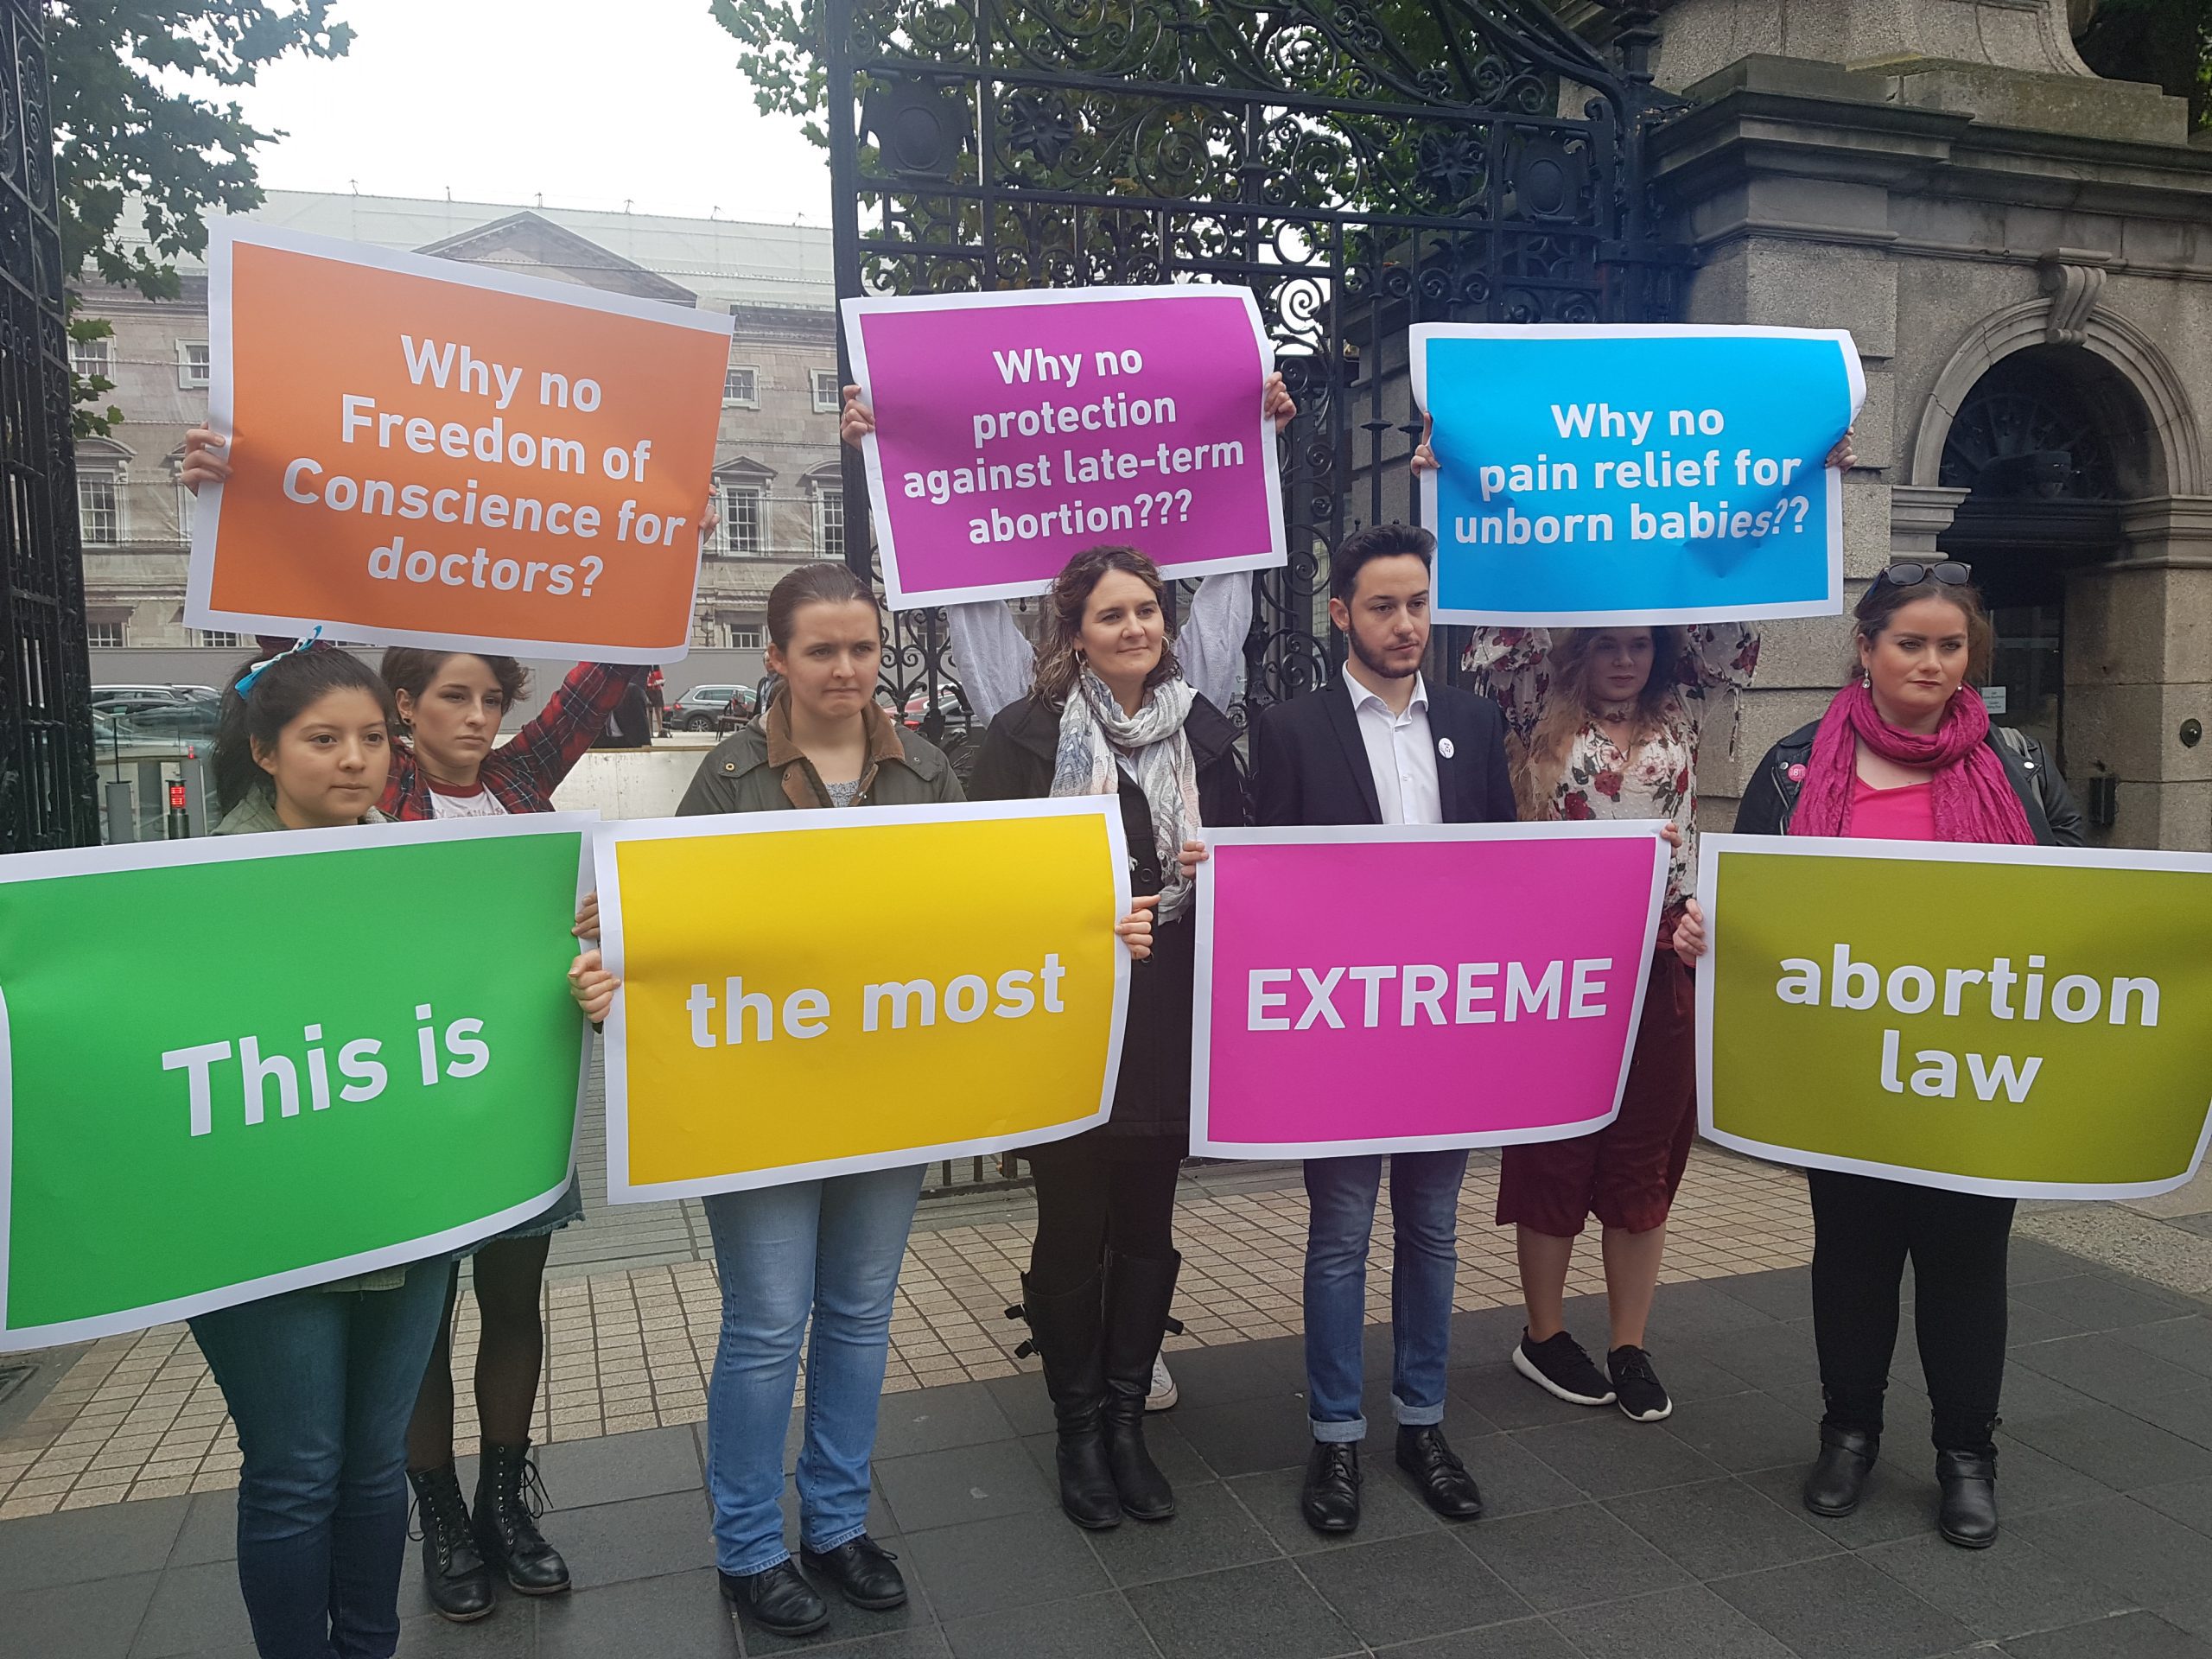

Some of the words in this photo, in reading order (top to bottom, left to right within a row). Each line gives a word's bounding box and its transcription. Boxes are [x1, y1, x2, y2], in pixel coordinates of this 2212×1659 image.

[401, 334, 524, 410] Why
[540, 371, 602, 413] no
[993, 347, 1083, 388] Why
[1095, 349, 1143, 377] no
[341, 394, 586, 475] Freedom
[602, 439, 652, 483] of
[973, 391, 1176, 449] protection
[1551, 403, 1653, 446] Why
[1669, 409, 1725, 435] no
[283, 457, 601, 538] Conscience
[617, 499, 687, 547] for
[903, 454, 1052, 505] against
[1064, 442, 1244, 484] late-term
[1480, 454, 1577, 501] pain
[1594, 450, 1719, 489] relief
[1735, 449, 1802, 486] for
[969, 488, 1192, 544] abortion???
[1455, 507, 1613, 544] unborn
[1630, 496, 1809, 540] babies??
[367, 536, 604, 597] doctors?
[685, 976, 830, 1048] the
[862, 953, 1066, 1032] most
[1247, 957, 1612, 1031] EXTREME
[1776, 943, 2160, 1027] abortion
[161, 1023, 388, 1137] This
[415, 1003, 490, 1086] is
[1880, 1028, 2044, 1103] law
